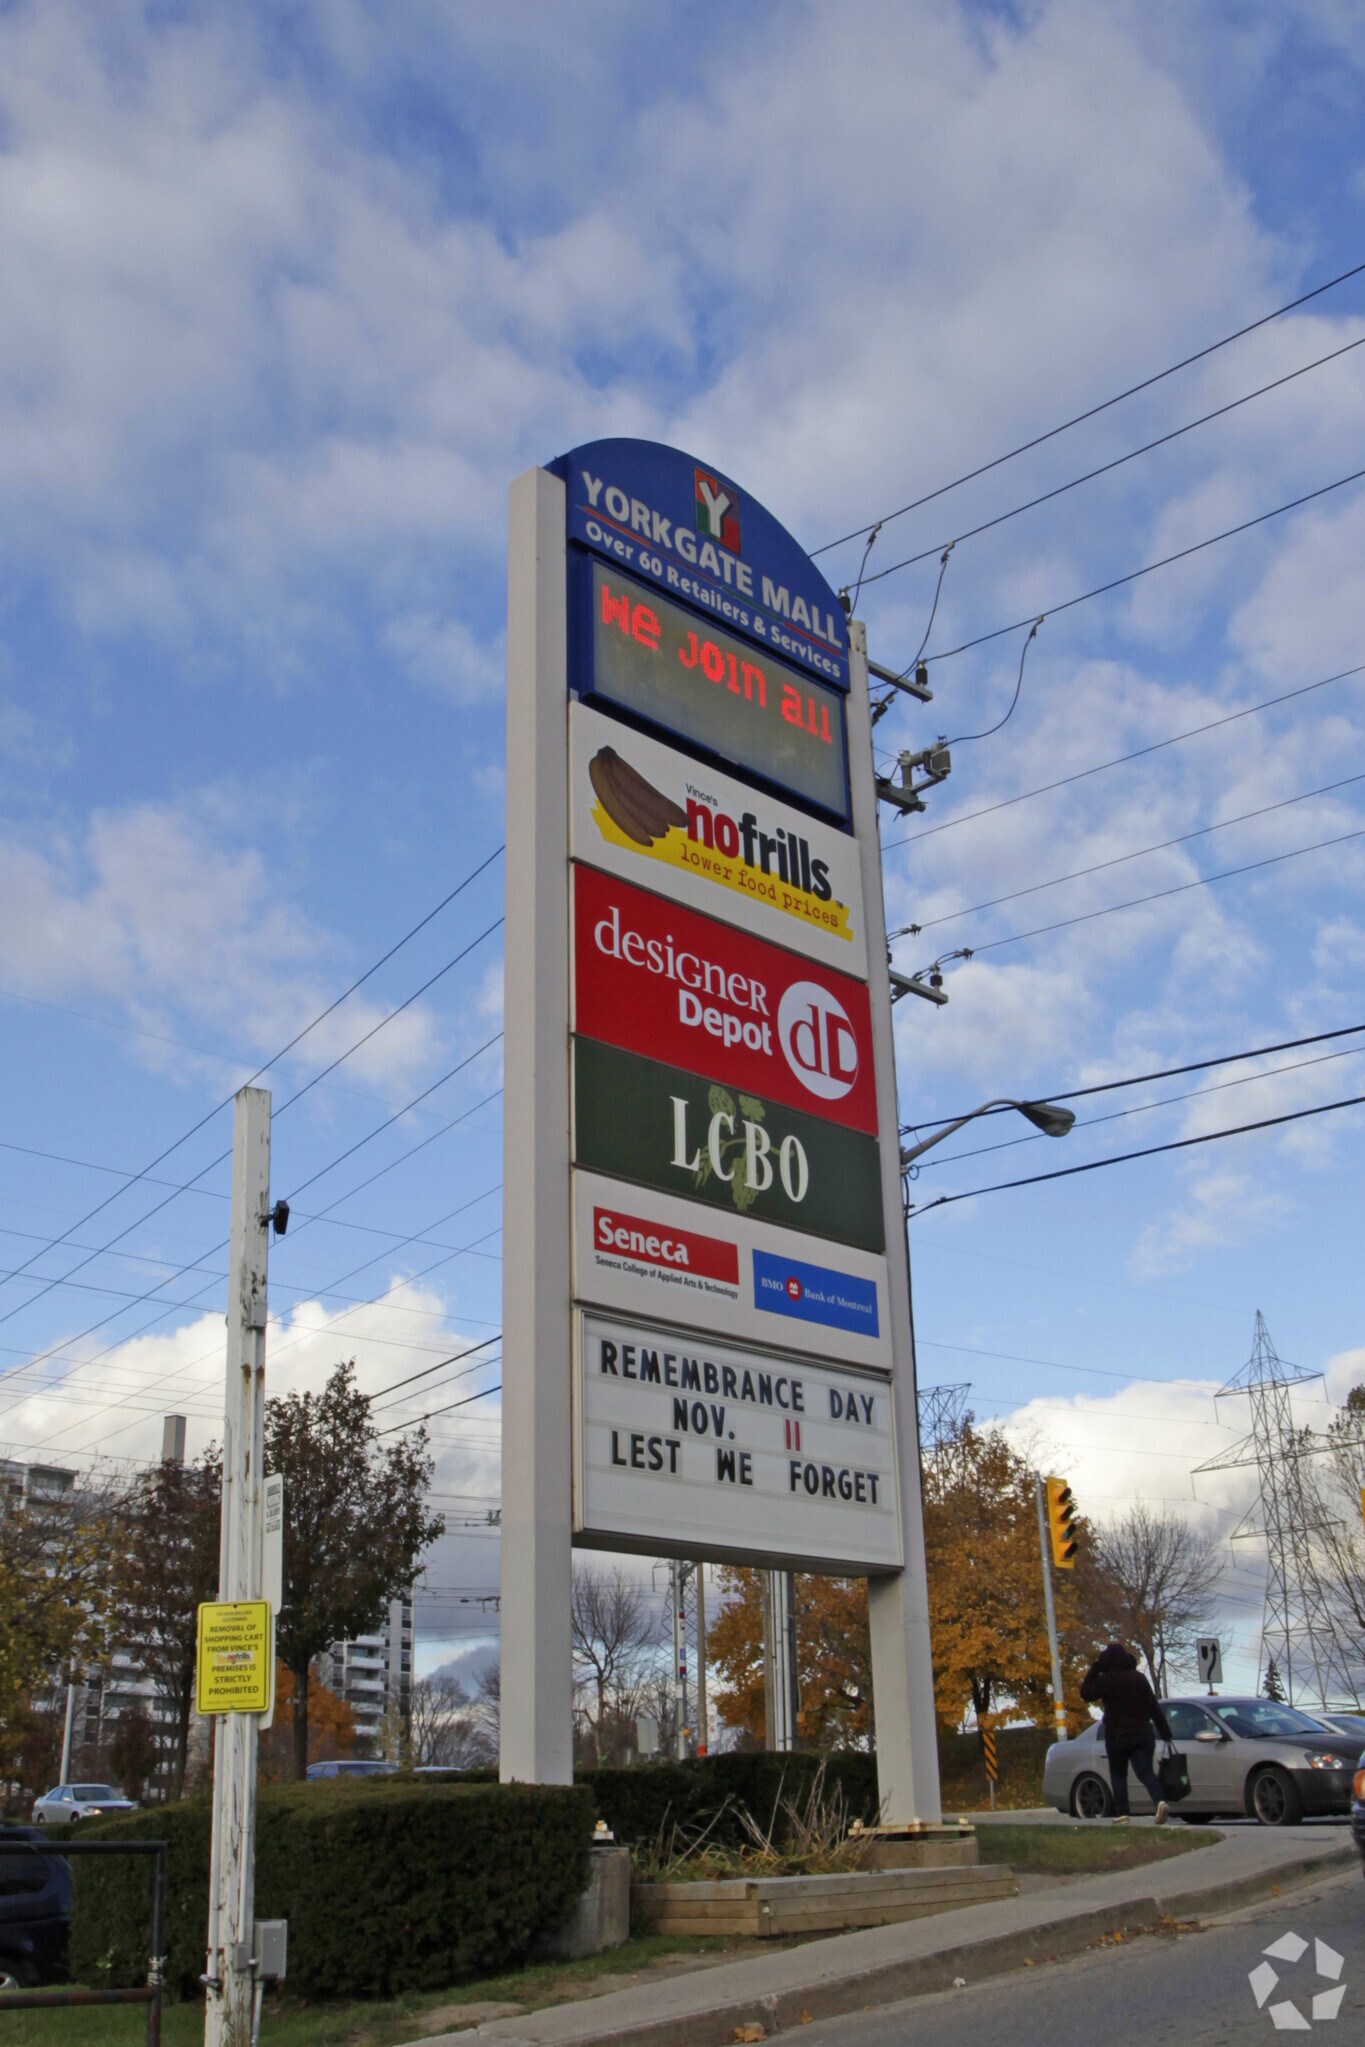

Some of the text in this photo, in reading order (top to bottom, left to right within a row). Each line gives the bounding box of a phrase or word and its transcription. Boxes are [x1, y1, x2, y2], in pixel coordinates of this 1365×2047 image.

[581, 470, 843, 649] YORKGATE MALL
[585, 520, 841, 678] Over 60 Retailers & Services
[685, 783, 719, 808] Vince's
[680, 843, 839, 928] lower food prices
[678, 988, 773, 1056] Depot
[670, 1095, 809, 1202] LCBO
[598, 1216, 690, 1265] Seneca
[595, 1255, 738, 1300] Seneca College of Applied Arts & Technology
[761, 1277, 873, 1314] BMO Bank of Montreal
[601, 1340, 874, 1425] REMEMBRANCE DAY
[673, 1397, 735, 1440] NOV.
[611, 1431, 880, 1504] LEST WE FORGET
[204, 1633, 263, 1643] SHOPPING CART
[210, 1625, 245, 1633] REMOVAL
[230, 1644, 259, 1652] VINCE'S
[212, 1663, 257, 1673] PREMISES IS
[214, 1675, 252, 1684] STRICTLY
[208, 1685, 259, 1696] PROHIBITED
